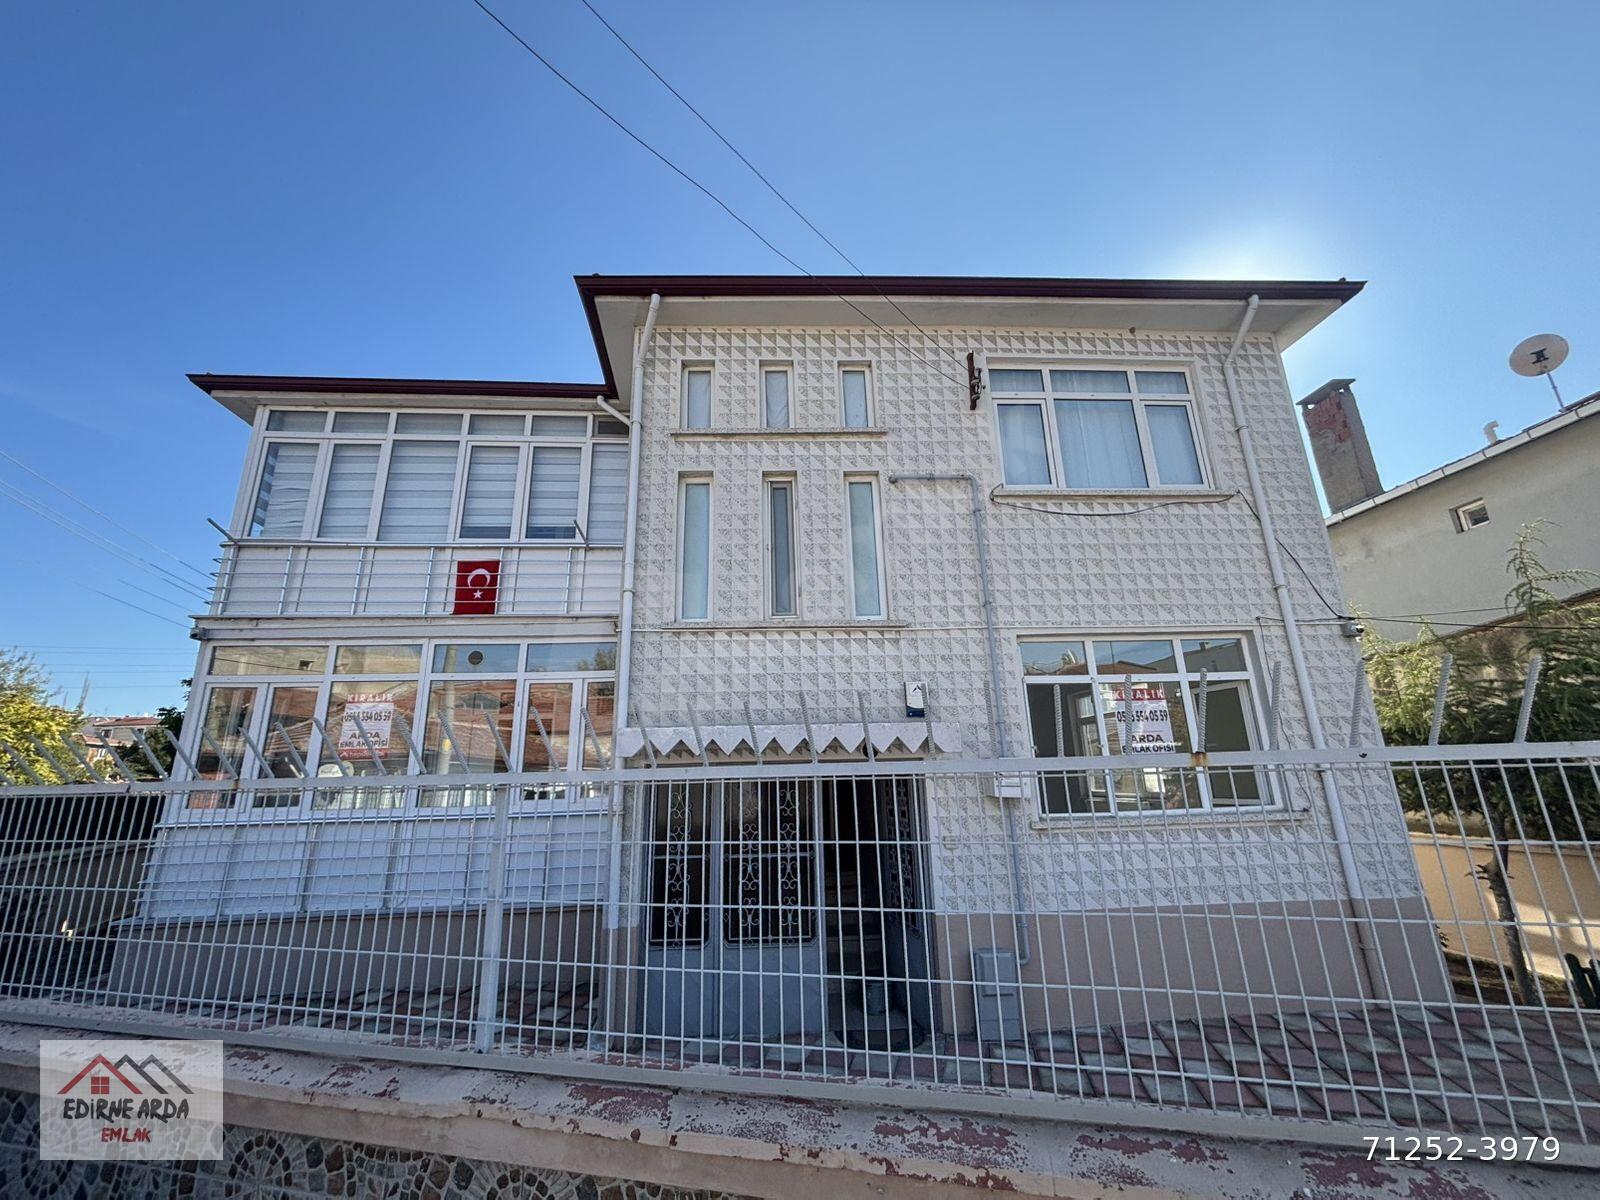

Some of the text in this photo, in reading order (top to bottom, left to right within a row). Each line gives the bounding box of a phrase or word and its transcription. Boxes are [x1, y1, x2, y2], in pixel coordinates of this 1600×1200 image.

[347, 693, 393, 702] KIRALIK
[1113, 689, 1164, 699] KIALIK
[1149, 709, 1159, 722] 05
[1159, 709, 1168, 721] 59
[1130, 734, 1163, 743] ARDA
